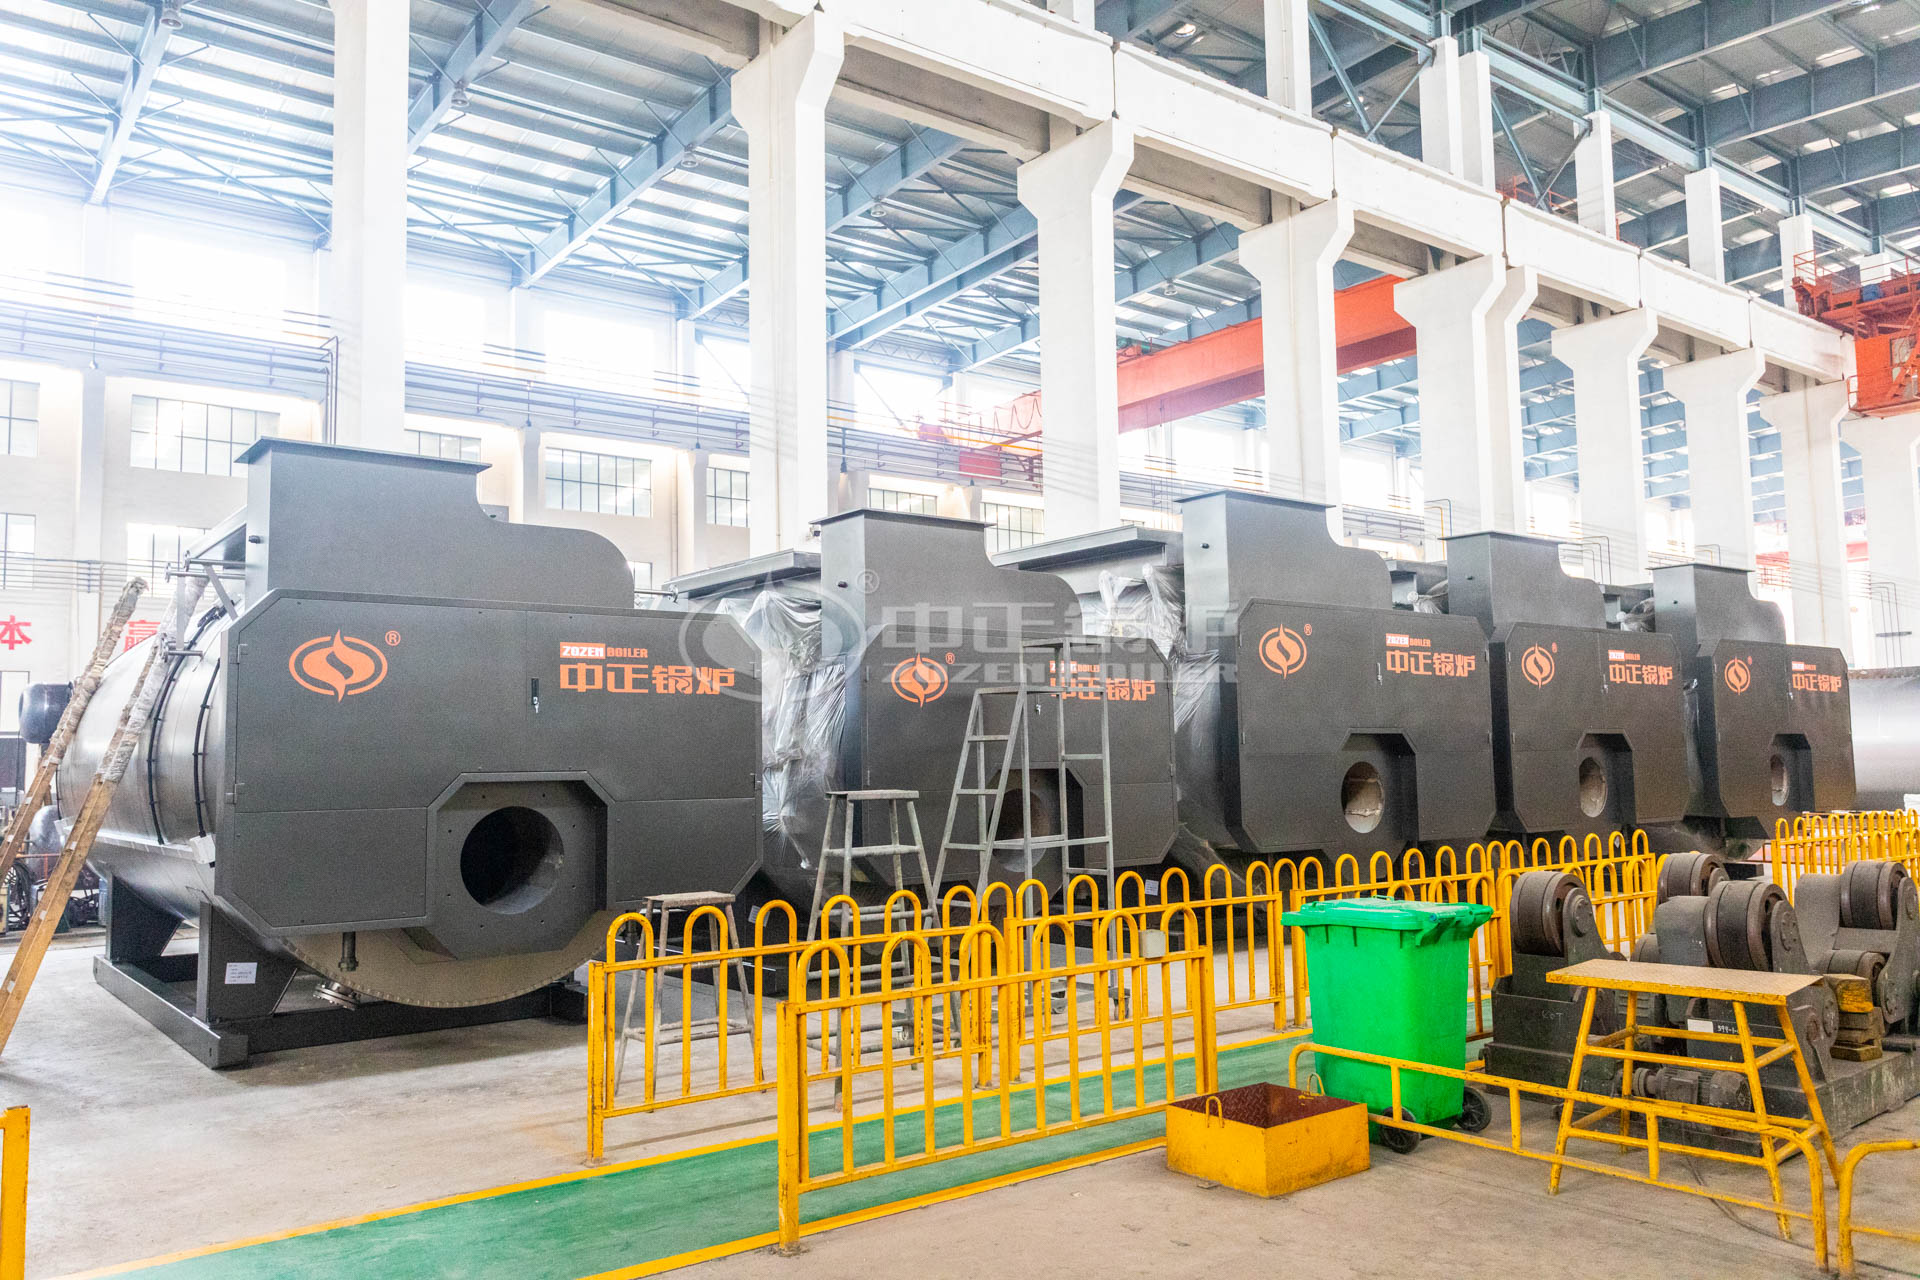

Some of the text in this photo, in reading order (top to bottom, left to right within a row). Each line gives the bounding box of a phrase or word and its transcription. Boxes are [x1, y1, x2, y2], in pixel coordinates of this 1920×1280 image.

[0, 615, 33, 650] 本
[561, 645, 649, 659] ZOZEN BOILER
[1386, 649, 1476, 678] 中正锅炉
[559, 662, 736, 695] 中正锅炉
[1608, 663, 1674, 686] 中正锅炉
[1792, 673, 1842, 693] 中正锅炉
